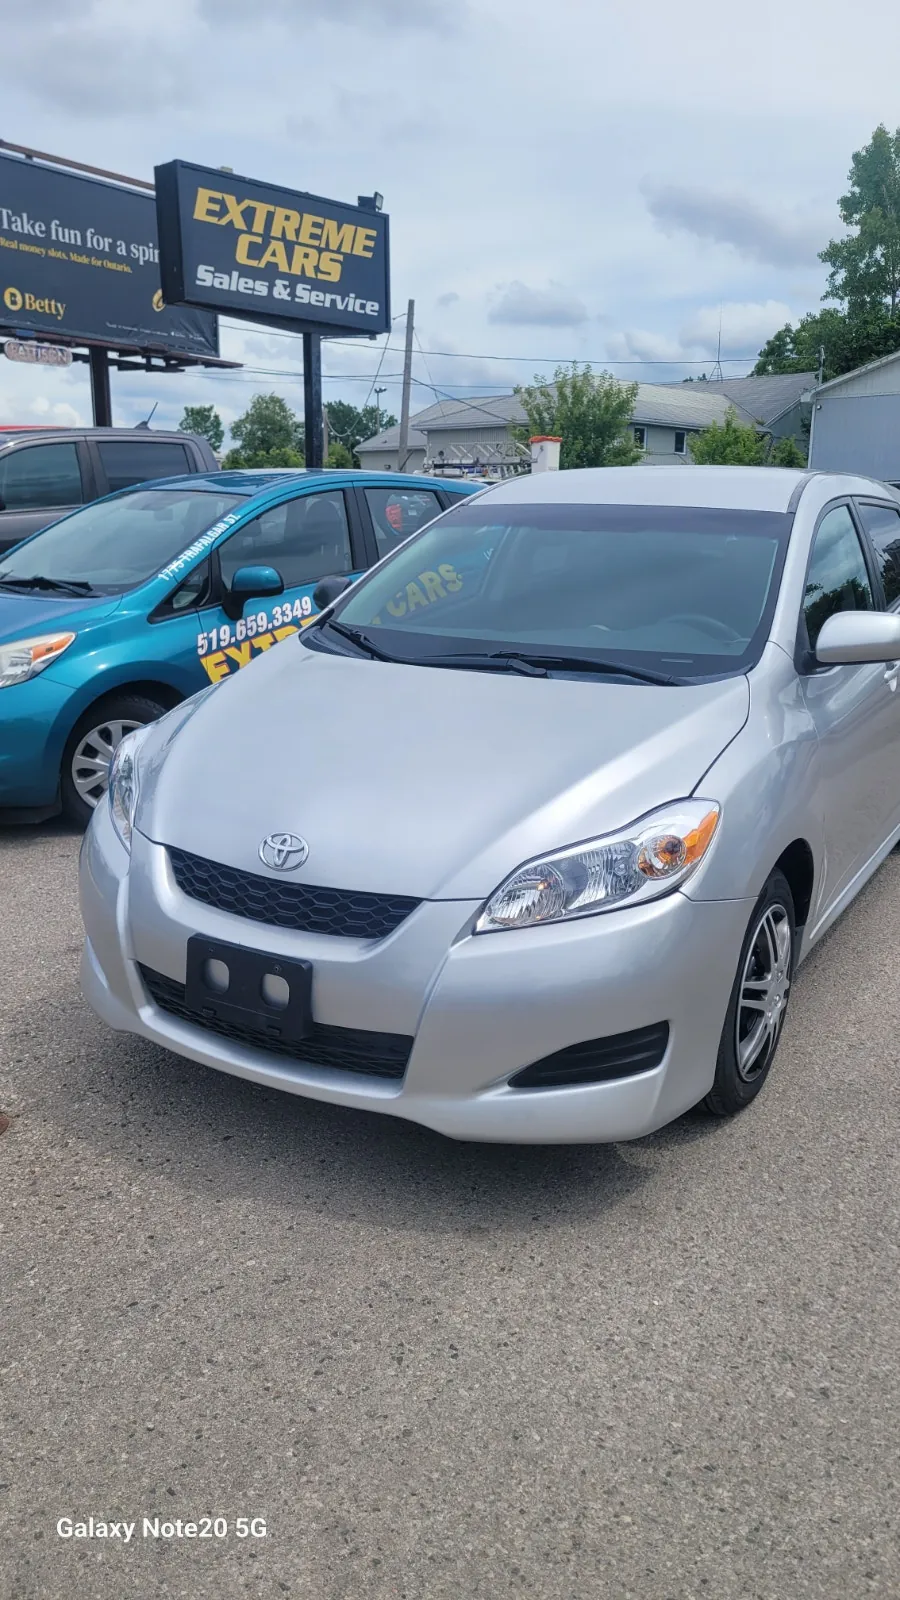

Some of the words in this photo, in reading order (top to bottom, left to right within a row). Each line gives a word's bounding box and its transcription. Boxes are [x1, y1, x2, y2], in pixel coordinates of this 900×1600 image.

[0, 207, 46, 238] Take
[50, 219, 82, 246] fun
[86, 228, 113, 253] for
[116, 239, 127, 256] a
[193, 187, 377, 259] EXTREME
[19, 243, 46, 258] money
[70, 252, 90, 265] Made
[91, 256, 102, 268] for
[103, 259, 133, 274] Ontario.
[235, 234, 344, 283] CARS
[24, 292, 66, 320] Betty
[195, 264, 270, 297] Sales
[272, 279, 292, 301] &
[294, 283, 380, 316] Service
[178, 521, 230, 562] TRAFALGAR
[386, 563, 463, 617] CARS
[197, 596, 312, 656] 519.659.3349
